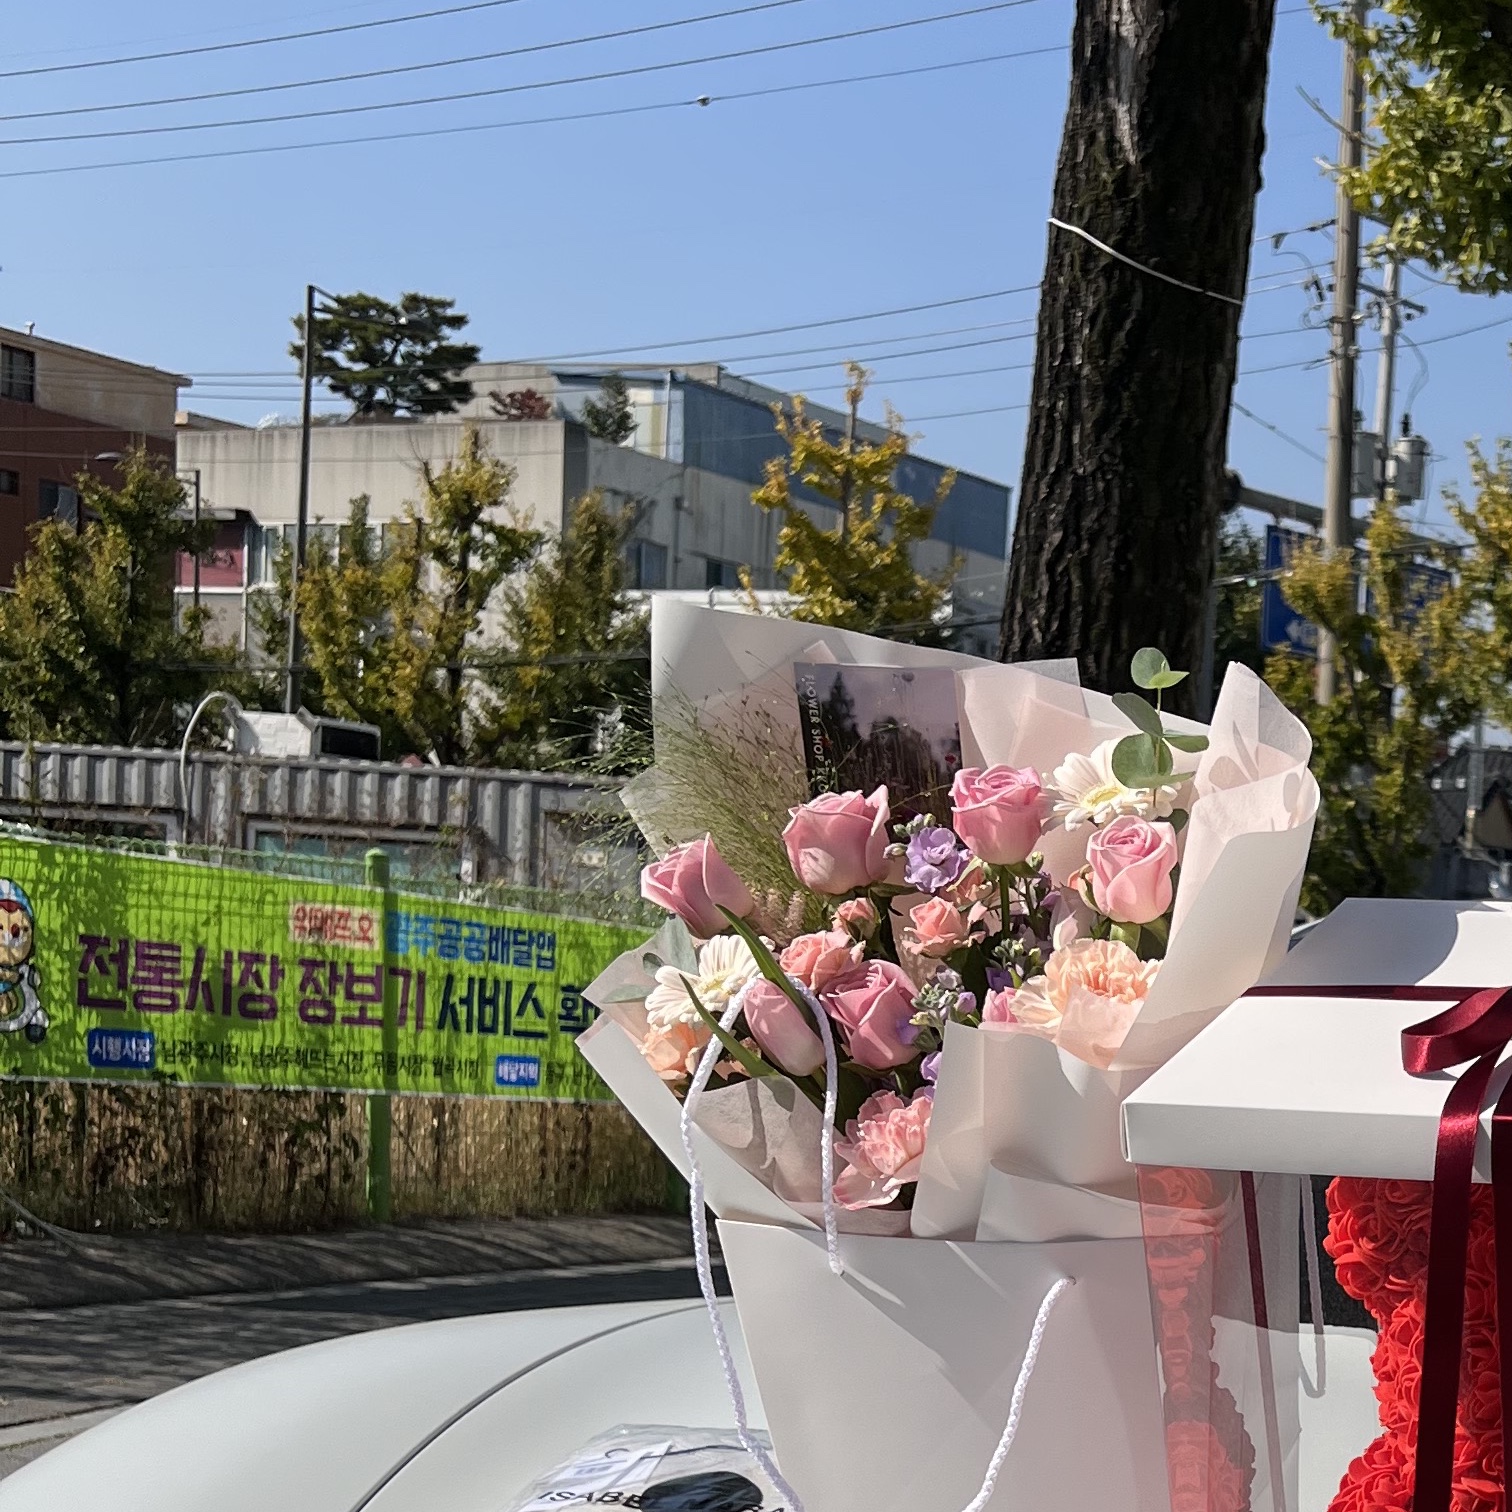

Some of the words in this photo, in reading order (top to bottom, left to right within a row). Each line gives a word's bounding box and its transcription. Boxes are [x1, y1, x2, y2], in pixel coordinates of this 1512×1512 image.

[811, 729, 825, 762] SHOP
[77, 933, 285, 1021] 전통시장
[298, 957, 426, 1034] 장보기
[437, 973, 549, 1041] 서비스
[557, 984, 602, 1035] 확
[537, 1490, 644, 1510] ISABE
